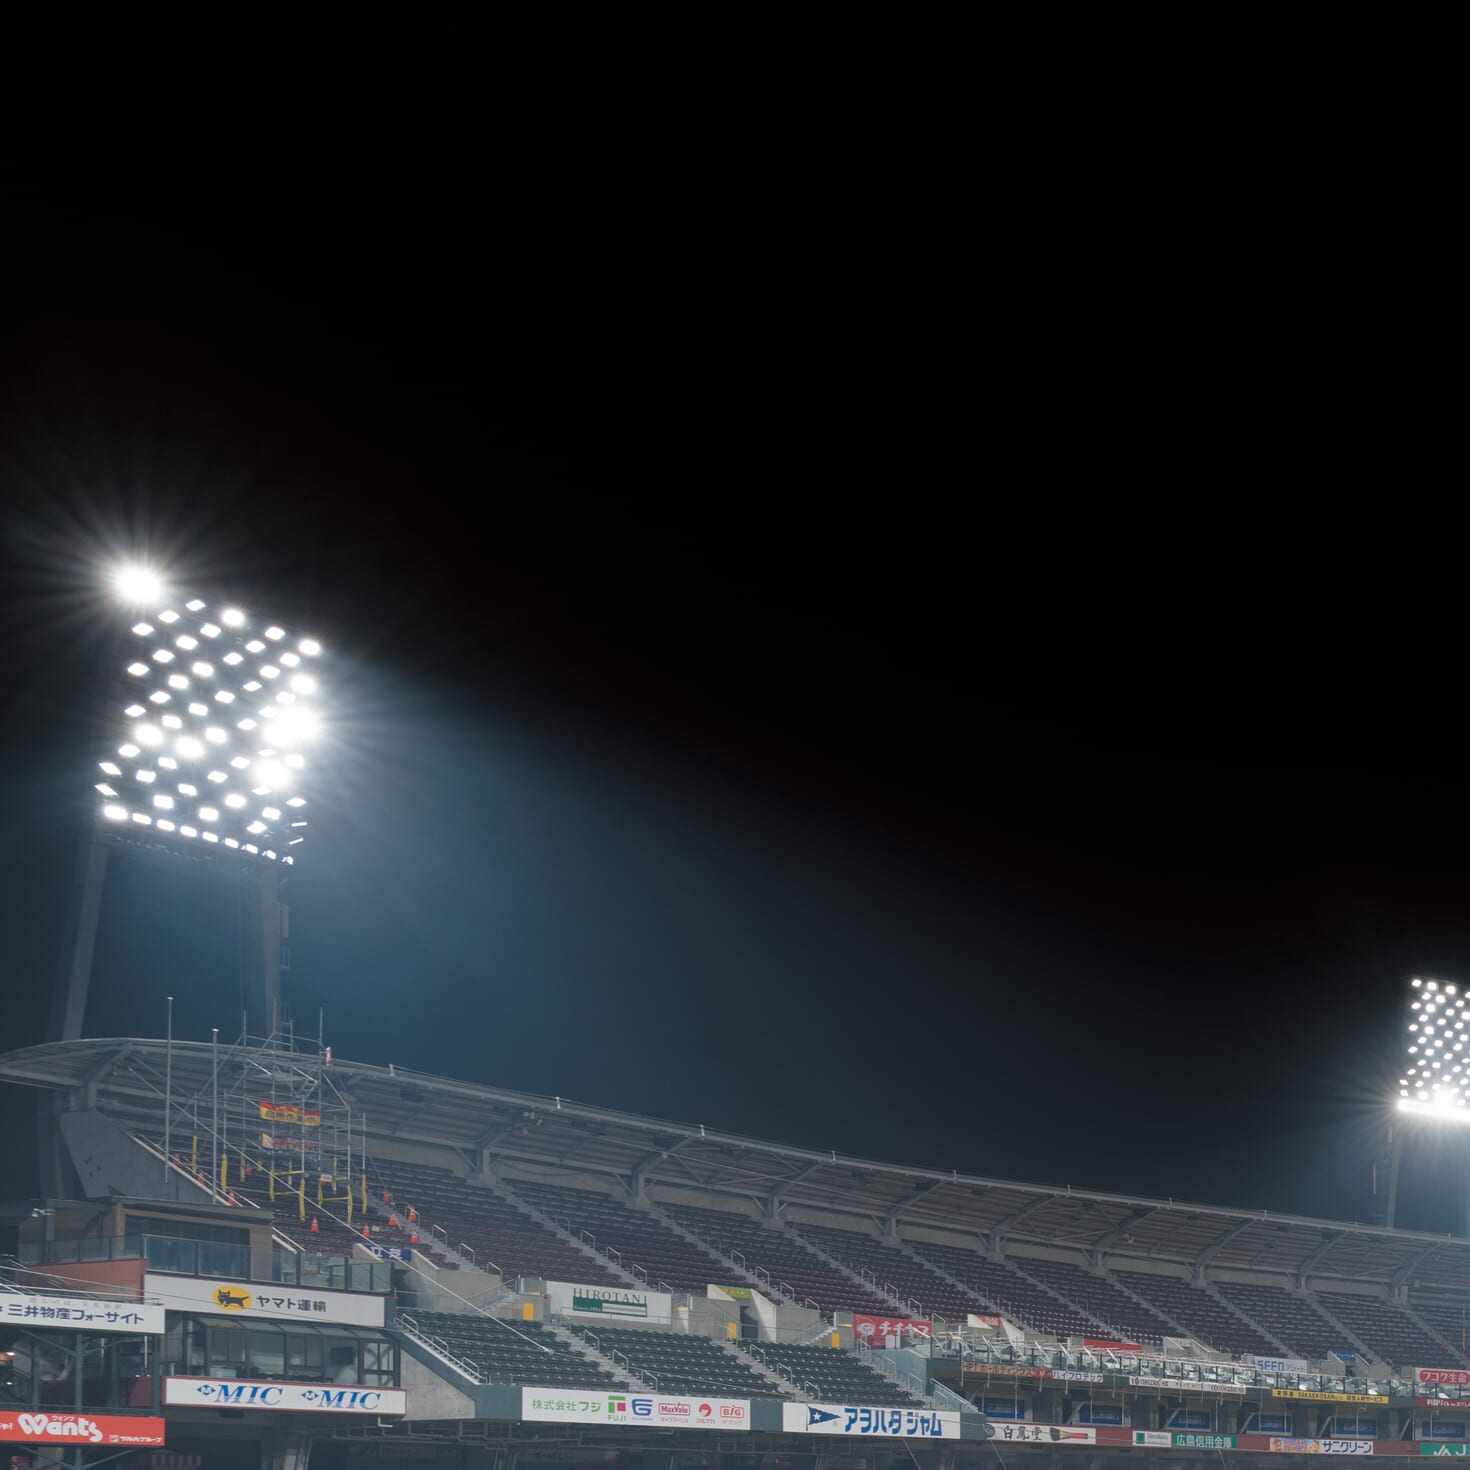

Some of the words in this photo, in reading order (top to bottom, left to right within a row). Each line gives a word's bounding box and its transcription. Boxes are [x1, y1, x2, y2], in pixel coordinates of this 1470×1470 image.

[256, 1295, 327, 1312] ヤマト運輸
[573, 1288, 647, 1304] HIROTANI
[8, 1304, 145, 1325] 三井物産フォーサイト
[1421, 1372, 1468, 1383] フコク生命
[215, 1384, 283, 1405] MIC
[319, 1390, 381, 1410] MIC
[18, 1414, 103, 1442] Wants
[1176, 1434, 1232, 1448] 広島信用金庫
[1322, 1440, 1372, 1454] サニクリーン
